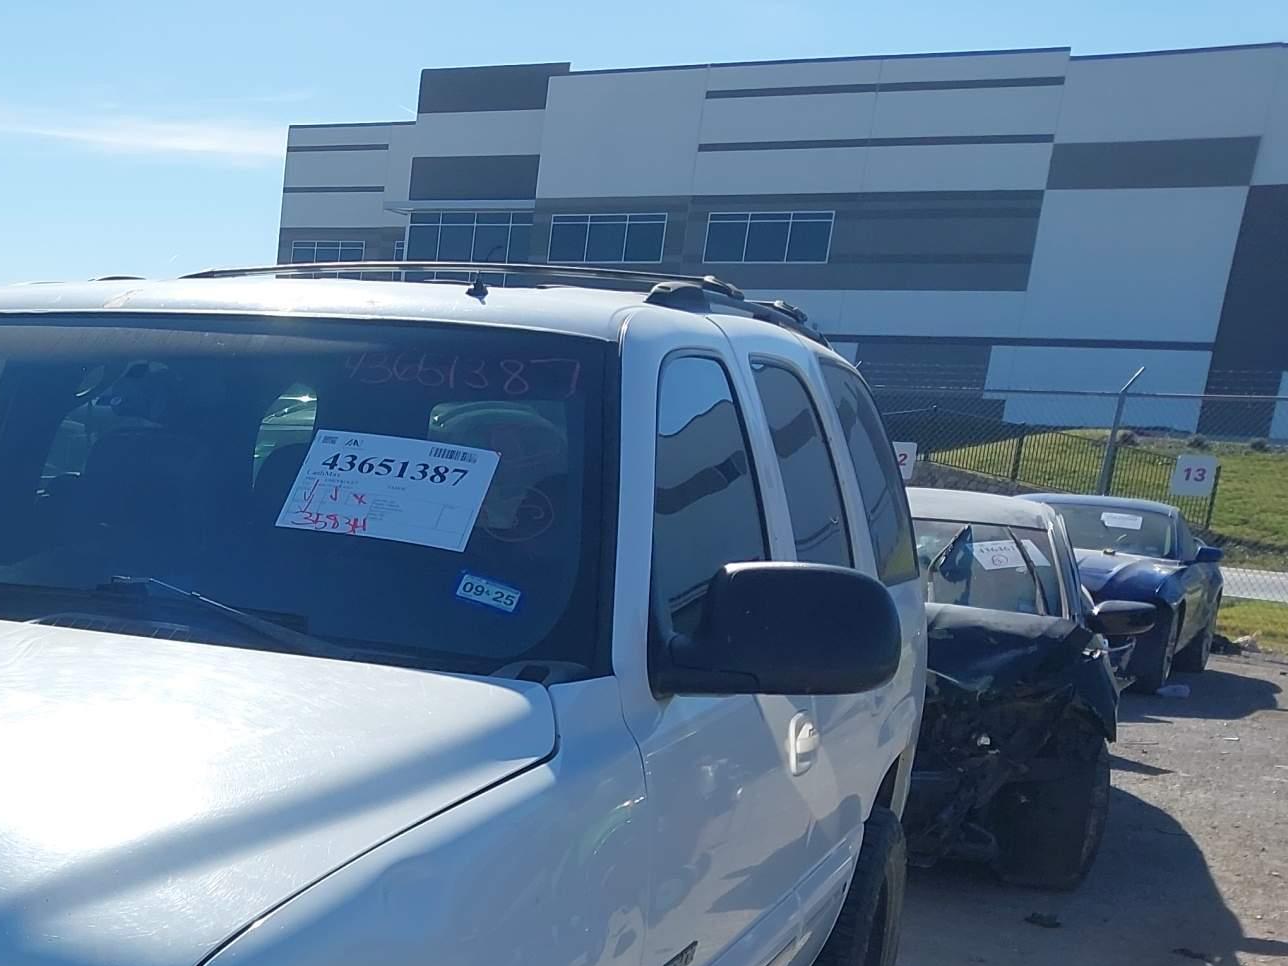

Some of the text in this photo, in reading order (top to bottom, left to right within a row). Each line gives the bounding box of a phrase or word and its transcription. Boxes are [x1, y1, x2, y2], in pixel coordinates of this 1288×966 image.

[321, 452, 470, 487] 43651387
[897, 453, 908, 466] 2
[1184, 467, 1207, 482] 13
[462, 581, 516, 606] 09 25
